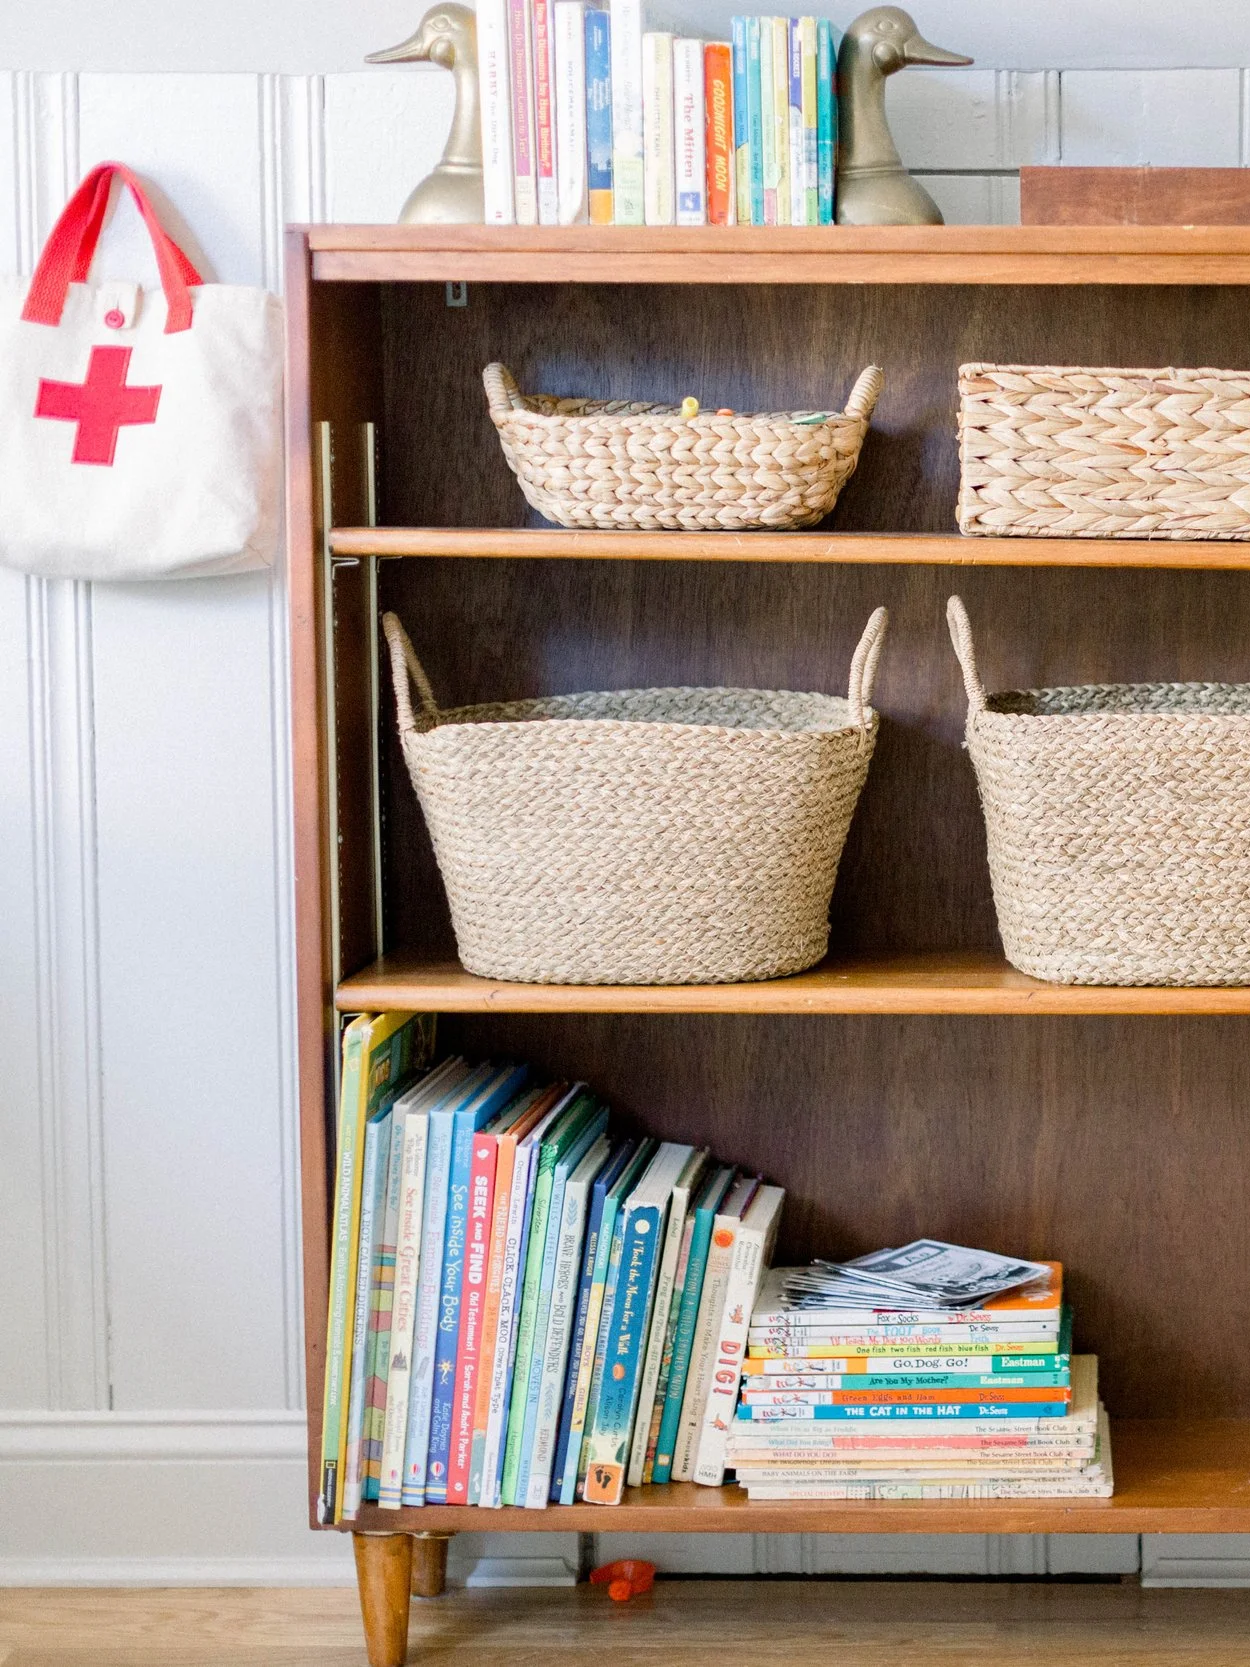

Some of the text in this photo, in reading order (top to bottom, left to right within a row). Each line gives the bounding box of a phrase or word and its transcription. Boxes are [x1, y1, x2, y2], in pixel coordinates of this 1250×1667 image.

[514, 10, 522, 28] How
[488, 51, 497, 97] HARRY
[537, 3, 550, 168] How Do Dinosaurs Happy Birthday?
[684, 92, 695, 178] The Mitten
[712, 79, 727, 192] GOODNIGHT MOON
[342, 1151, 352, 1176] WILD
[340, 1177, 351, 1212] ANIMAL
[339, 1214, 350, 1240] ATLAS
[495, 1205, 507, 1238] FRIEND
[534, 1198, 546, 1234] Silverstein
[671, 1217, 680, 1238] Lobel
[440, 1184, 468, 1332] See inside Your Body
[562, 1235, 575, 1256] BRAVE
[586, 1232, 598, 1276] MELISSA KRUGER
[599, 1223, 609, 1269] MACHOWSKI
[631, 1247, 643, 1267] Took
[398, 1187, 416, 1332] See inside Great Cities
[355, 1208, 370, 1345] A BOY CALLED DICKENS
[489, 1255, 501, 1293] FORGIVES
[491, 1160, 524, 1414] Cronin Lewin CLICK, CLACK, MOO Cows That Type
[556, 1260, 570, 1289] HEROES
[629, 1269, 639, 1282] the
[661, 1272, 671, 1297] Frog
[685, 1258, 700, 1296] EVERYONE
[333, 1274, 345, 1318] Astonishing
[416, 1231, 440, 1348] Famous Buildings
[581, 1288, 589, 1314] WHEREVER
[605, 1294, 613, 1307] THE
[625, 1284, 638, 1309] Moon
[458, 1175, 488, 1469] SEEK AND FIND Old Testament Sarah and André Parker
[553, 1304, 566, 1325] BOLD
[622, 1311, 634, 1325] for
[682, 1309, 693, 1335] CHILD
[877, 1313, 919, 1325] Fox Socks
[955, 1312, 992, 1323] Dr. Seuss
[617, 1333, 631, 1355] Walk
[653, 1319, 664, 1343] Toad
[547, 1327, 565, 1374] DEFENDERS
[584, 1345, 592, 1367] BOYS
[676, 1339, 689, 1371] SHOULD
[690, 1279, 721, 1416] Thoughts to Make Your Heart Sing
[904, 1345, 921, 1353] fish
[713, 1340, 741, 1396] DIG!
[893, 1358, 1046, 1369] Go, Dog. Go! Eastman
[529, 1358, 541, 1403] MOVES IN
[669, 1374, 684, 1399] KNOW
[869, 1375, 1024, 1386] Are You My Mother? Eastman
[979, 1393, 988, 1401] Dr.
[989, 1392, 1004, 1401] Seuss
[441, 1402, 451, 1421] Katie
[600, 1395, 613, 1436] Alison Jay
[611, 1387, 627, 1447] Carolyn Curtis
[845, 1405, 1008, 1416] THE CAT IN THE HAT Dr. Seuss
[432, 1416, 441, 1435] Colin
[430, 1437, 439, 1453] King
[538, 1428, 549, 1462] REDMOND
